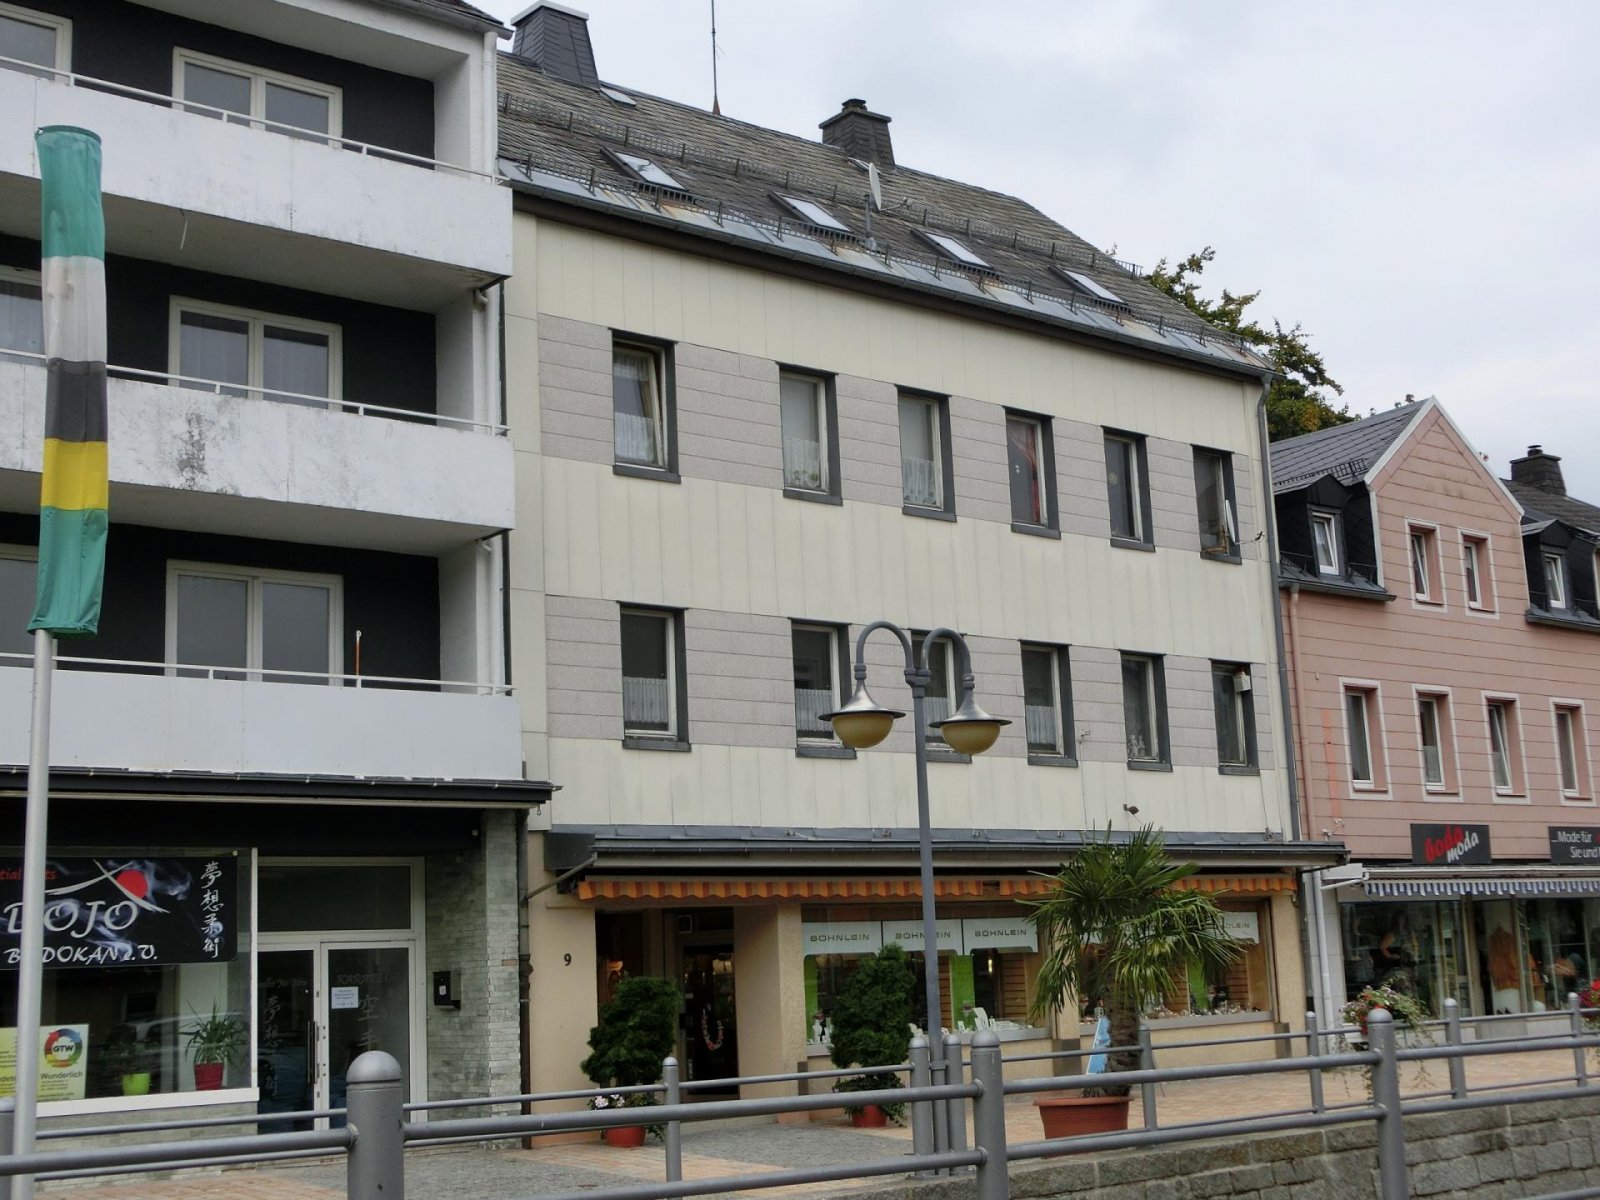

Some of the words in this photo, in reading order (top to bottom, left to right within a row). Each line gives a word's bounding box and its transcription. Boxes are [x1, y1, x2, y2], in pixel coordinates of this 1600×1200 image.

[1446, 830, 1479, 863] moda
[3, 945, 118, 965] BDOKAN
[563, 953, 572, 966] 9
[41, 1071, 83, 1080] Wunderlich
